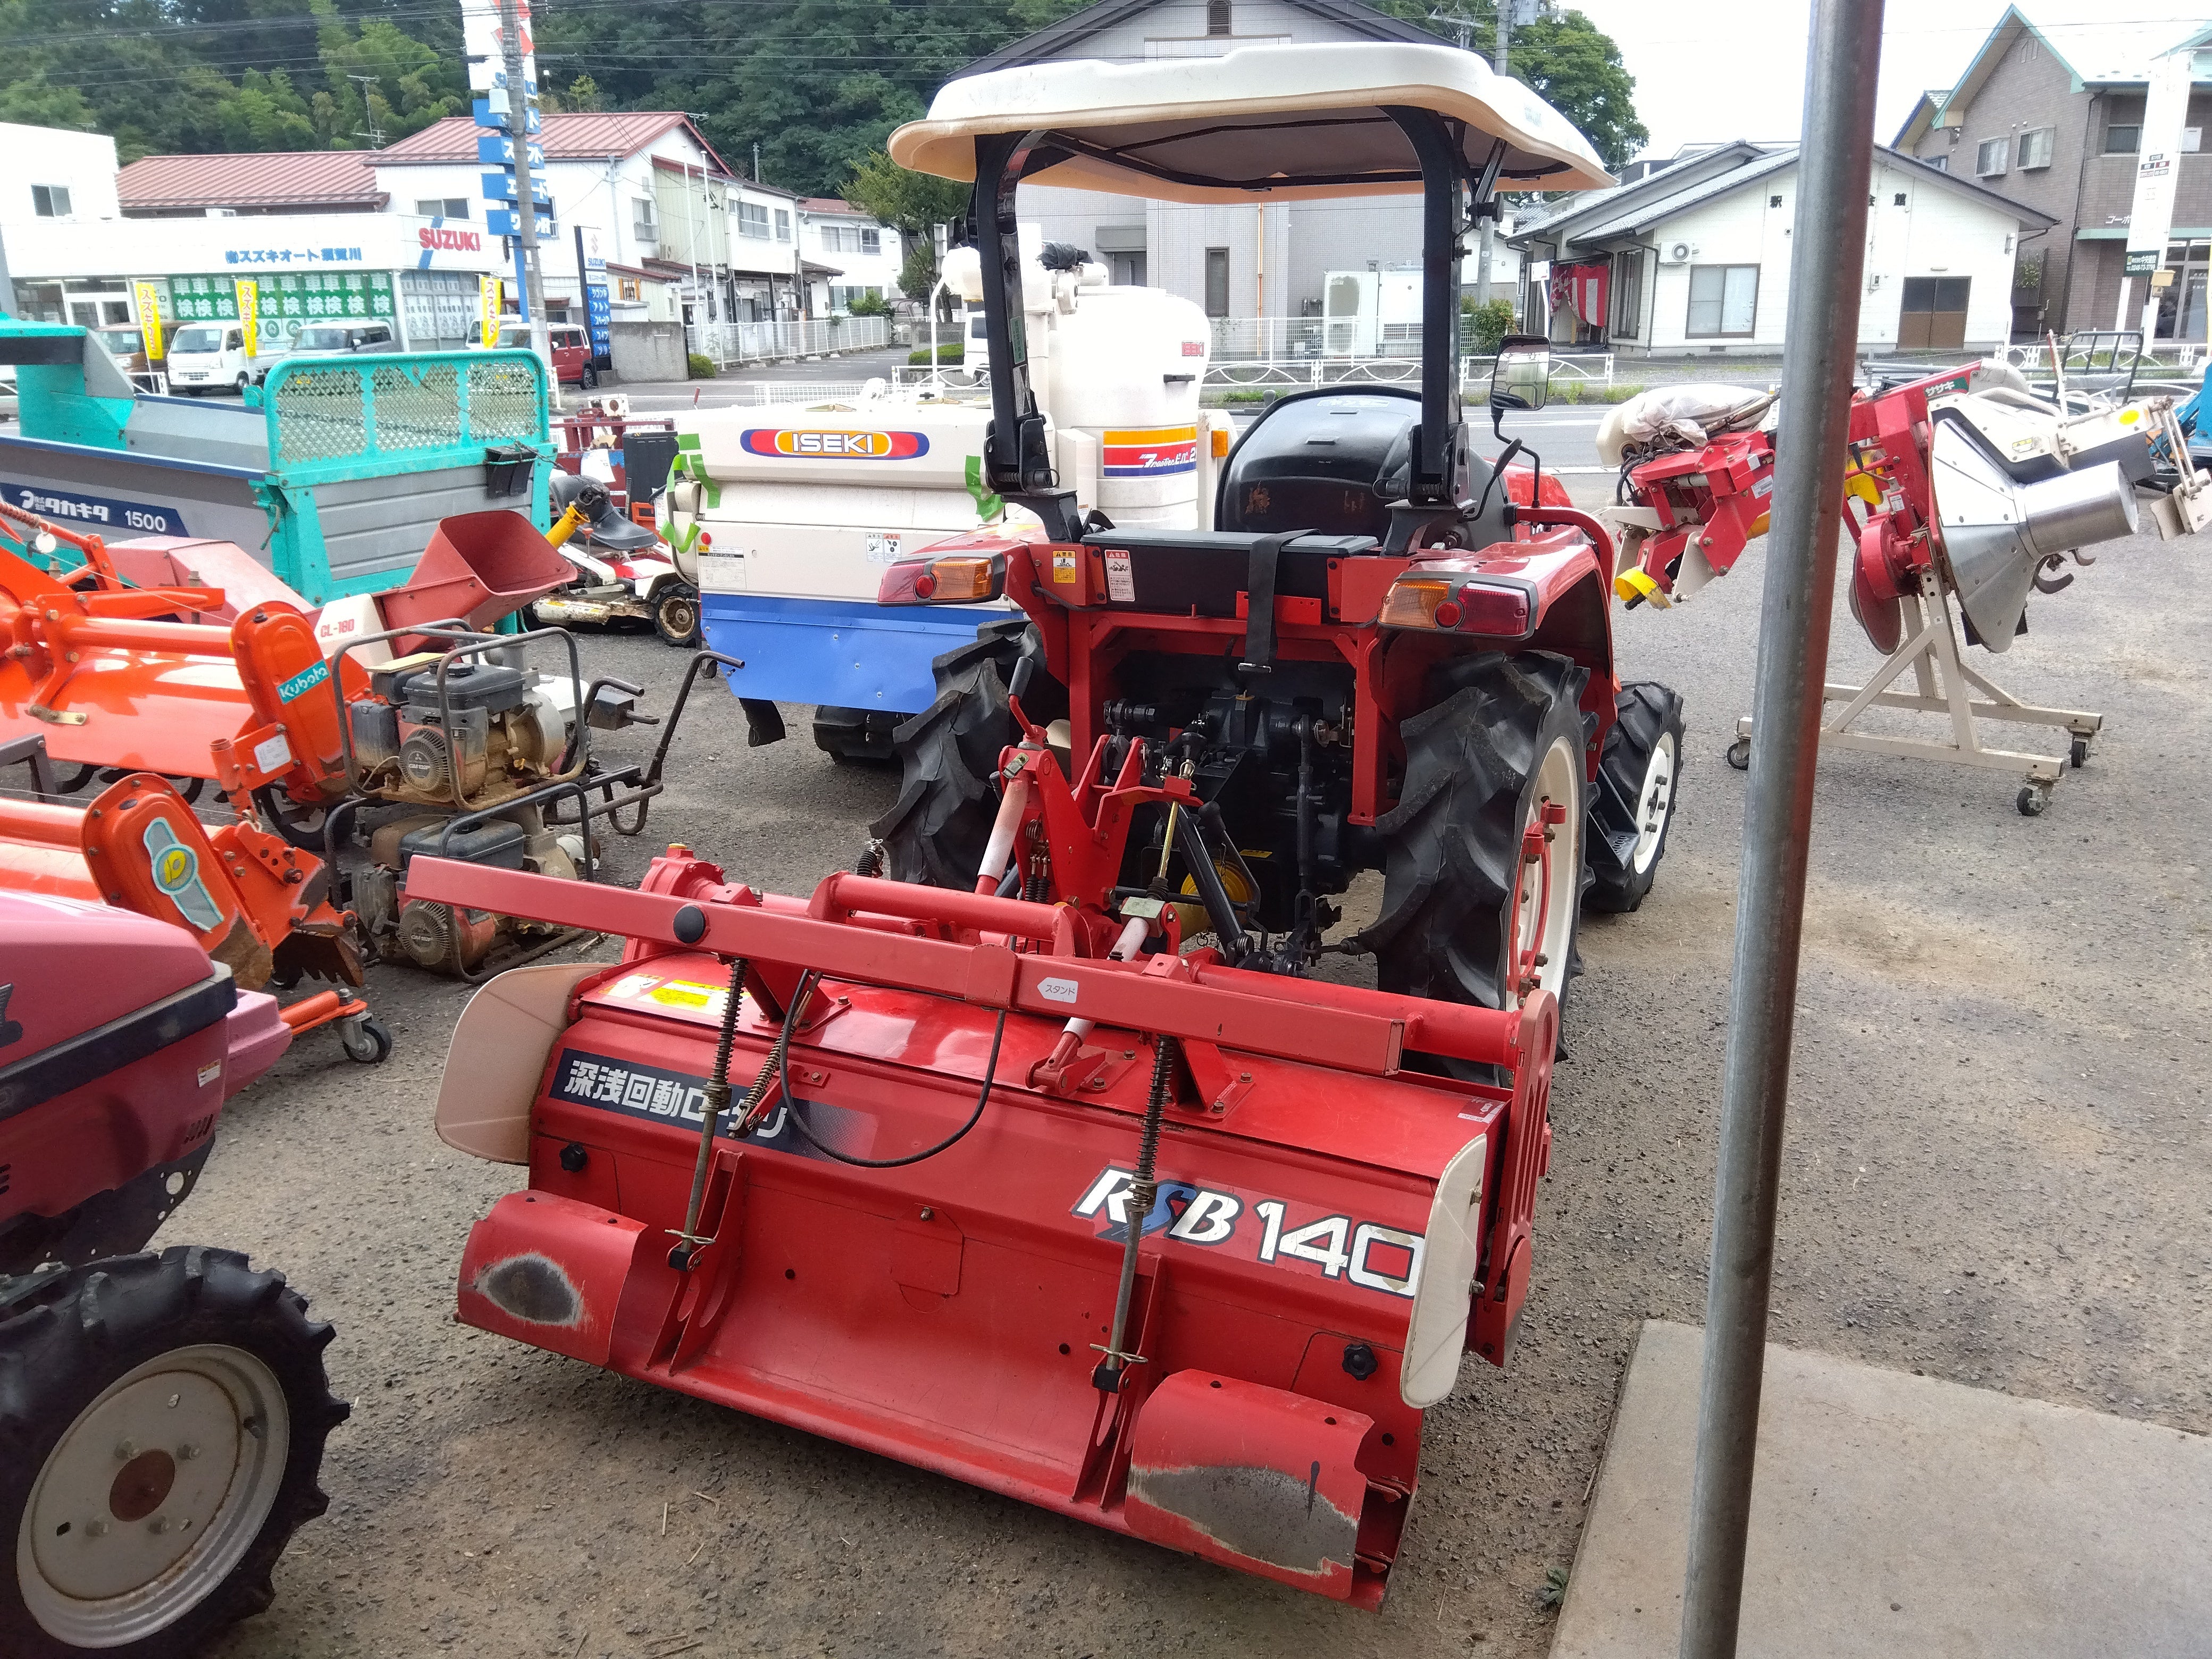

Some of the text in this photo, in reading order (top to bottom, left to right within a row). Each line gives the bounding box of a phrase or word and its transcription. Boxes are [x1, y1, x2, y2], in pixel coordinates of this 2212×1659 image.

[419, 228, 481, 251] SUZUKI
[588, 257, 605, 267] SUZUKI
[1182, 342, 1204, 357] ISEKI
[1925, 381, 1955, 396] ササキ
[793, 433, 873, 454] ISEKI
[45, 498, 108, 522] タカキタ
[125, 510, 166, 532] 1500
[280, 665, 328, 698] Kubota
[1045, 984, 1075, 996] スタンド
[564, 1060, 788, 1138] 深浅回動ロリ
[1256, 1200, 1425, 1297] 140
